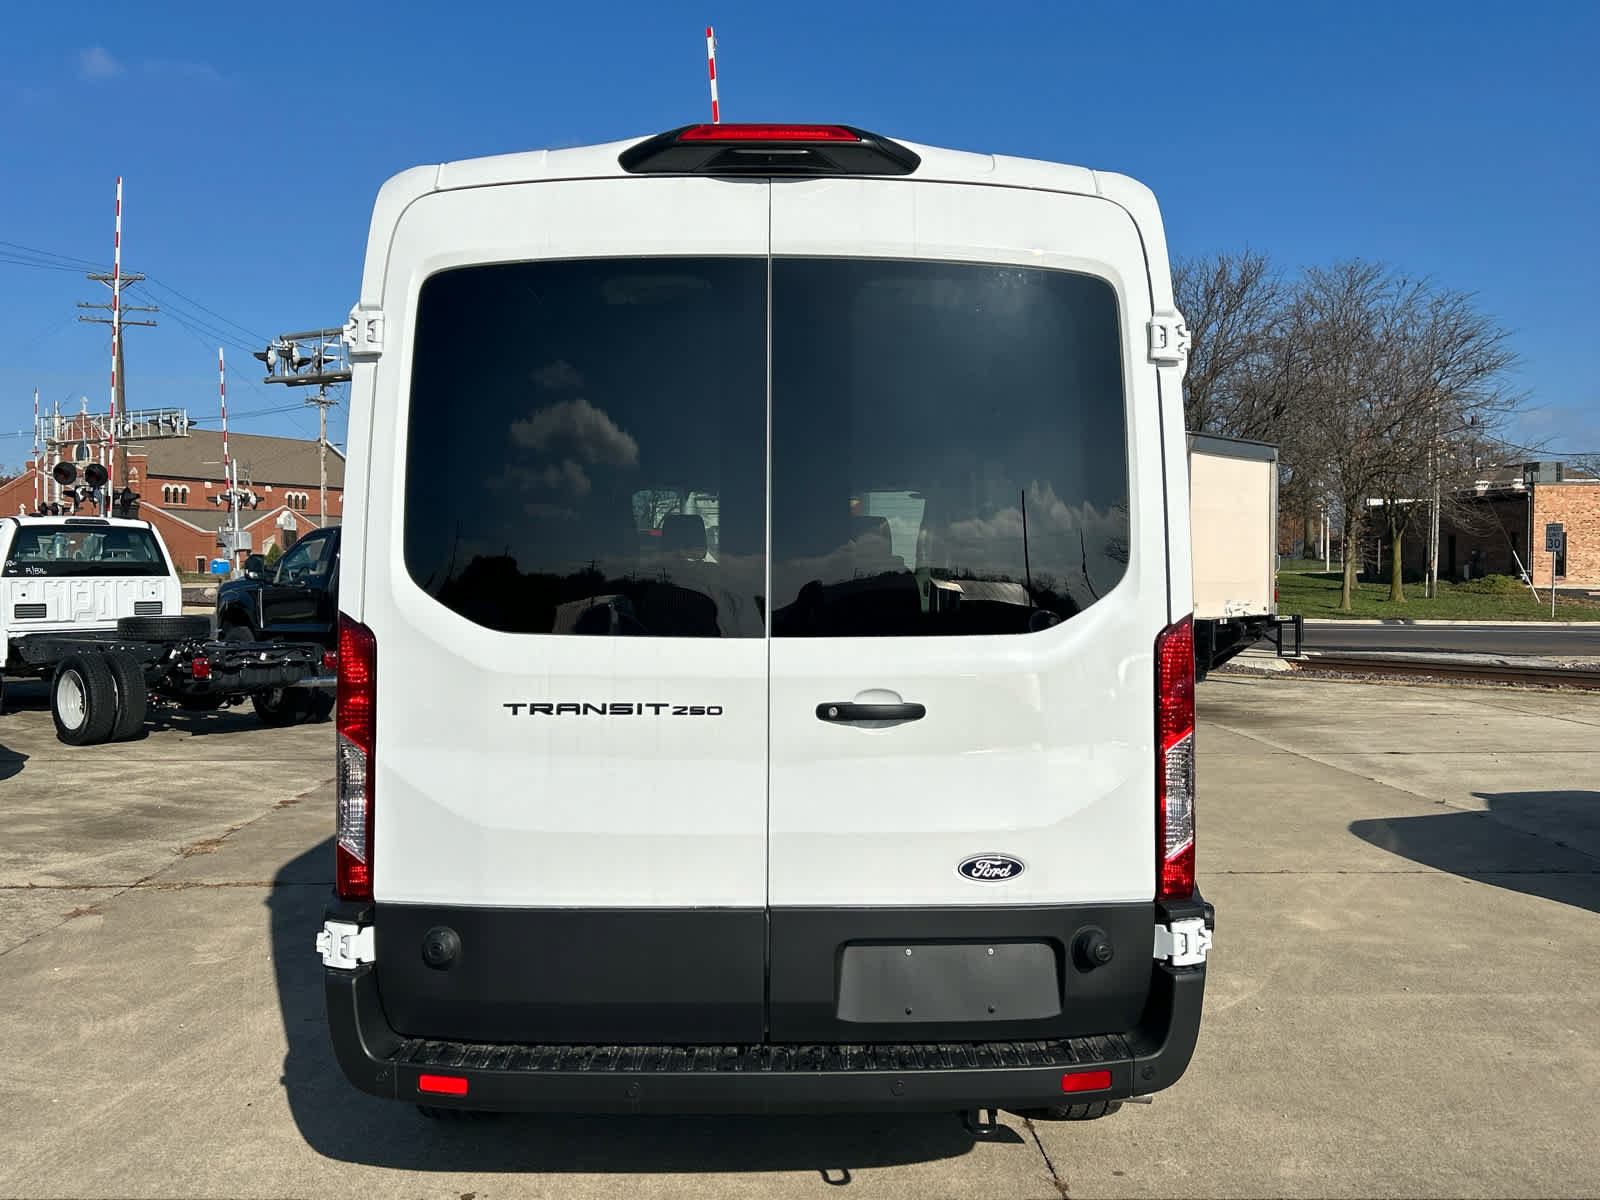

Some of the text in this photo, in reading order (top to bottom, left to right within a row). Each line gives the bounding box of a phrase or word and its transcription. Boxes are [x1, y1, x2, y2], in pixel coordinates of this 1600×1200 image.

[1547, 538, 1561, 549] 30
[503, 702, 723, 716] TRANSIT 250
[971, 860, 1012, 877] Ford
